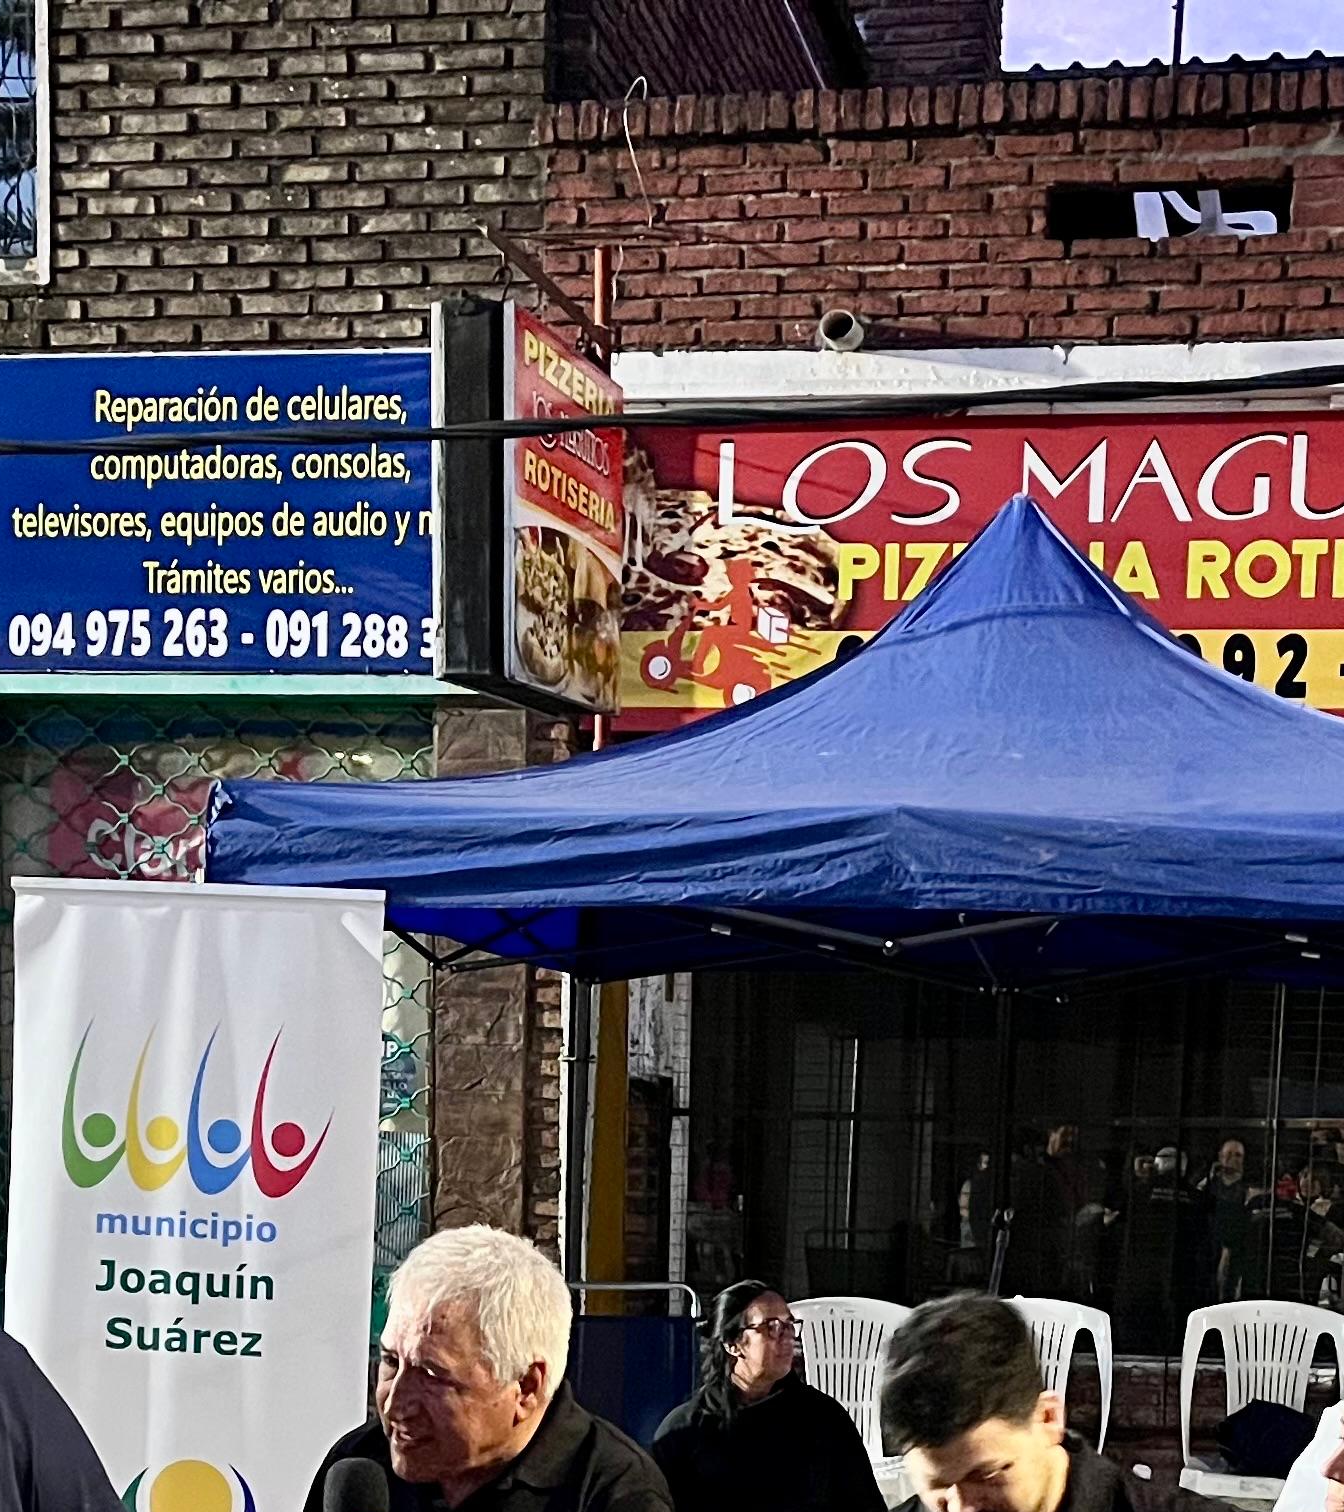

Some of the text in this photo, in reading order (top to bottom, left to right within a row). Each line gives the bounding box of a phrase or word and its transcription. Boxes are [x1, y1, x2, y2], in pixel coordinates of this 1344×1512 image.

[524, 329, 615, 416] PIZZERIA
[94, 385, 407, 431] Reparación de celulares,
[90, 443, 411, 488] computadoras, consolas,
[718, 438, 973, 534] LOS
[523, 448, 616, 535] ROTISERIA
[12, 503, 152, 542] televisores,
[160, 503, 264, 545] equipos
[271, 502, 305, 537] de
[312, 501, 387, 537] audio
[394, 510, 412, 545] y
[143, 559, 354, 595] Trámites varios...
[8, 611, 76, 657] 094
[85, 608, 151, 657] 975
[163, 607, 228, 657] 263
[266, 608, 329, 658] 091
[340, 612, 408, 658] 288
[96, 1210, 278, 1247] municipio
[95, 1259, 275, 1305] Joaquín
[104, 1316, 263, 1357] Suárez
